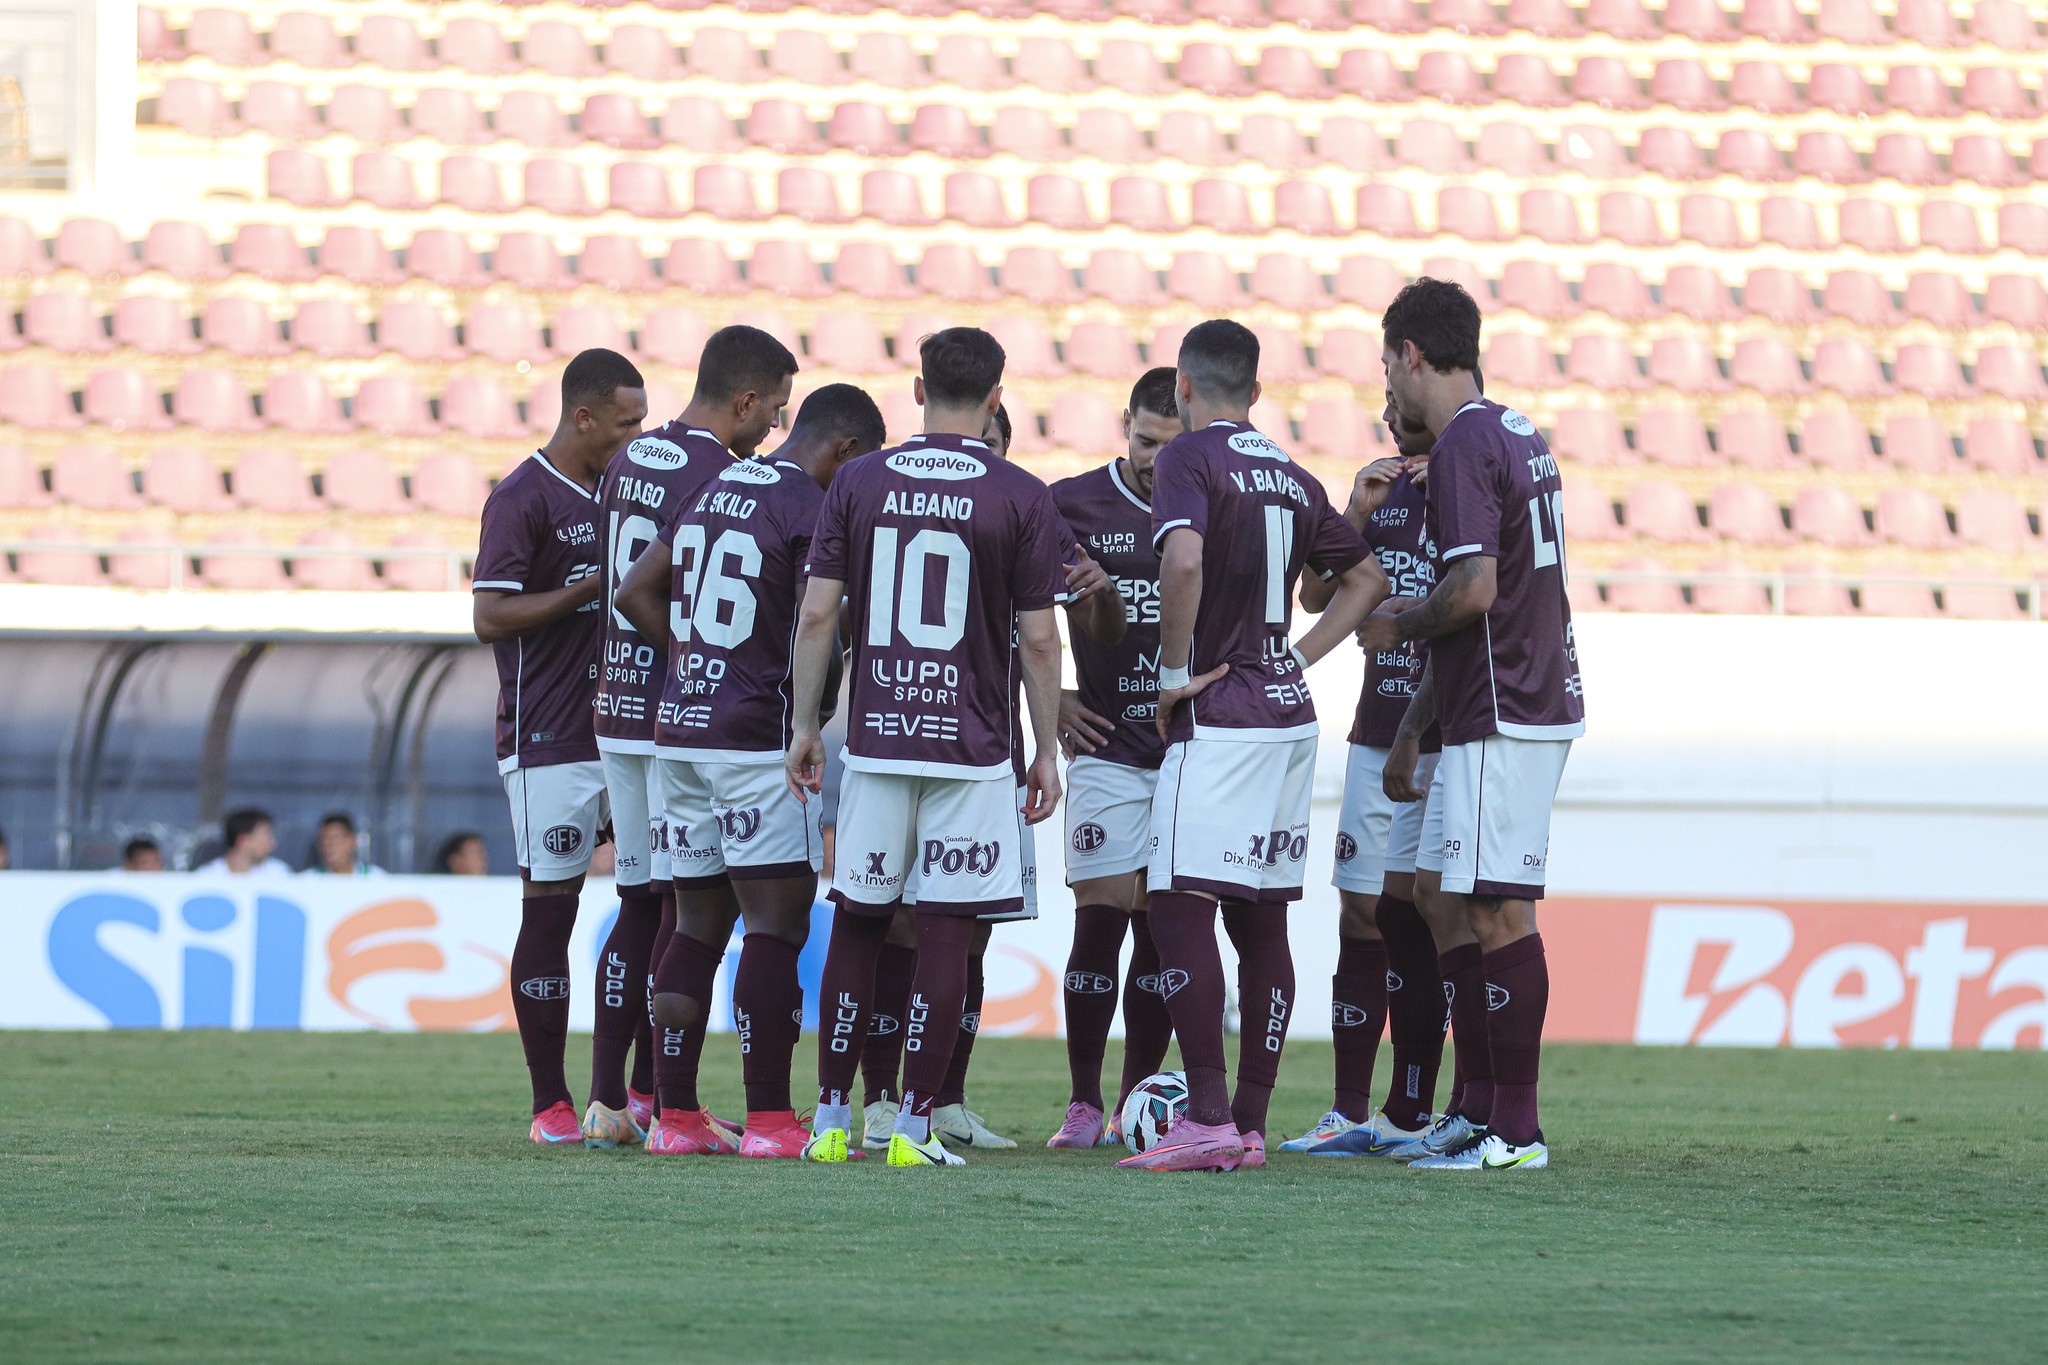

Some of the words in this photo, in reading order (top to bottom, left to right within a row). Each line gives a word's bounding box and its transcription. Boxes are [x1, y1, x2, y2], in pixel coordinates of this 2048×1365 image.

[894, 454, 977, 474] DrogaVen
[709, 491, 757, 520] SKILO
[882, 490, 974, 521] ALBANO
[1371, 508, 1409, 522] LUPO
[556, 522, 594, 541] LUPO
[1379, 518, 1407, 528] SPORT
[571, 533, 596, 545] SPORT
[1089, 532, 1135, 548] LUPO
[1102, 544, 1135, 554] SPORT
[669, 525, 763, 651] 36
[868, 526, 971, 652] 10
[604, 639, 654, 668] UPO
[605, 667, 651, 685] SPORT
[872, 658, 959, 688] LUPO
[894, 686, 958, 706] SPORT
[545, 829, 578, 851] AFE
[1073, 827, 1102, 851] AFE
[1265, 830, 1309, 867] Po
[921, 839, 1002, 878] Poty
[1223, 850, 1245, 865] Dix
[1523, 854, 1542, 867] Dix
[865, 872, 901, 886] Invest
[524, 979, 569, 998] AFE
[605, 951, 627, 1008] LUPO
[1066, 975, 1105, 991] AFE
[831, 992, 859, 1053] LUPO
[906, 993, 929, 1053] LUPO
[1265, 987, 1288, 1053] LUPO
